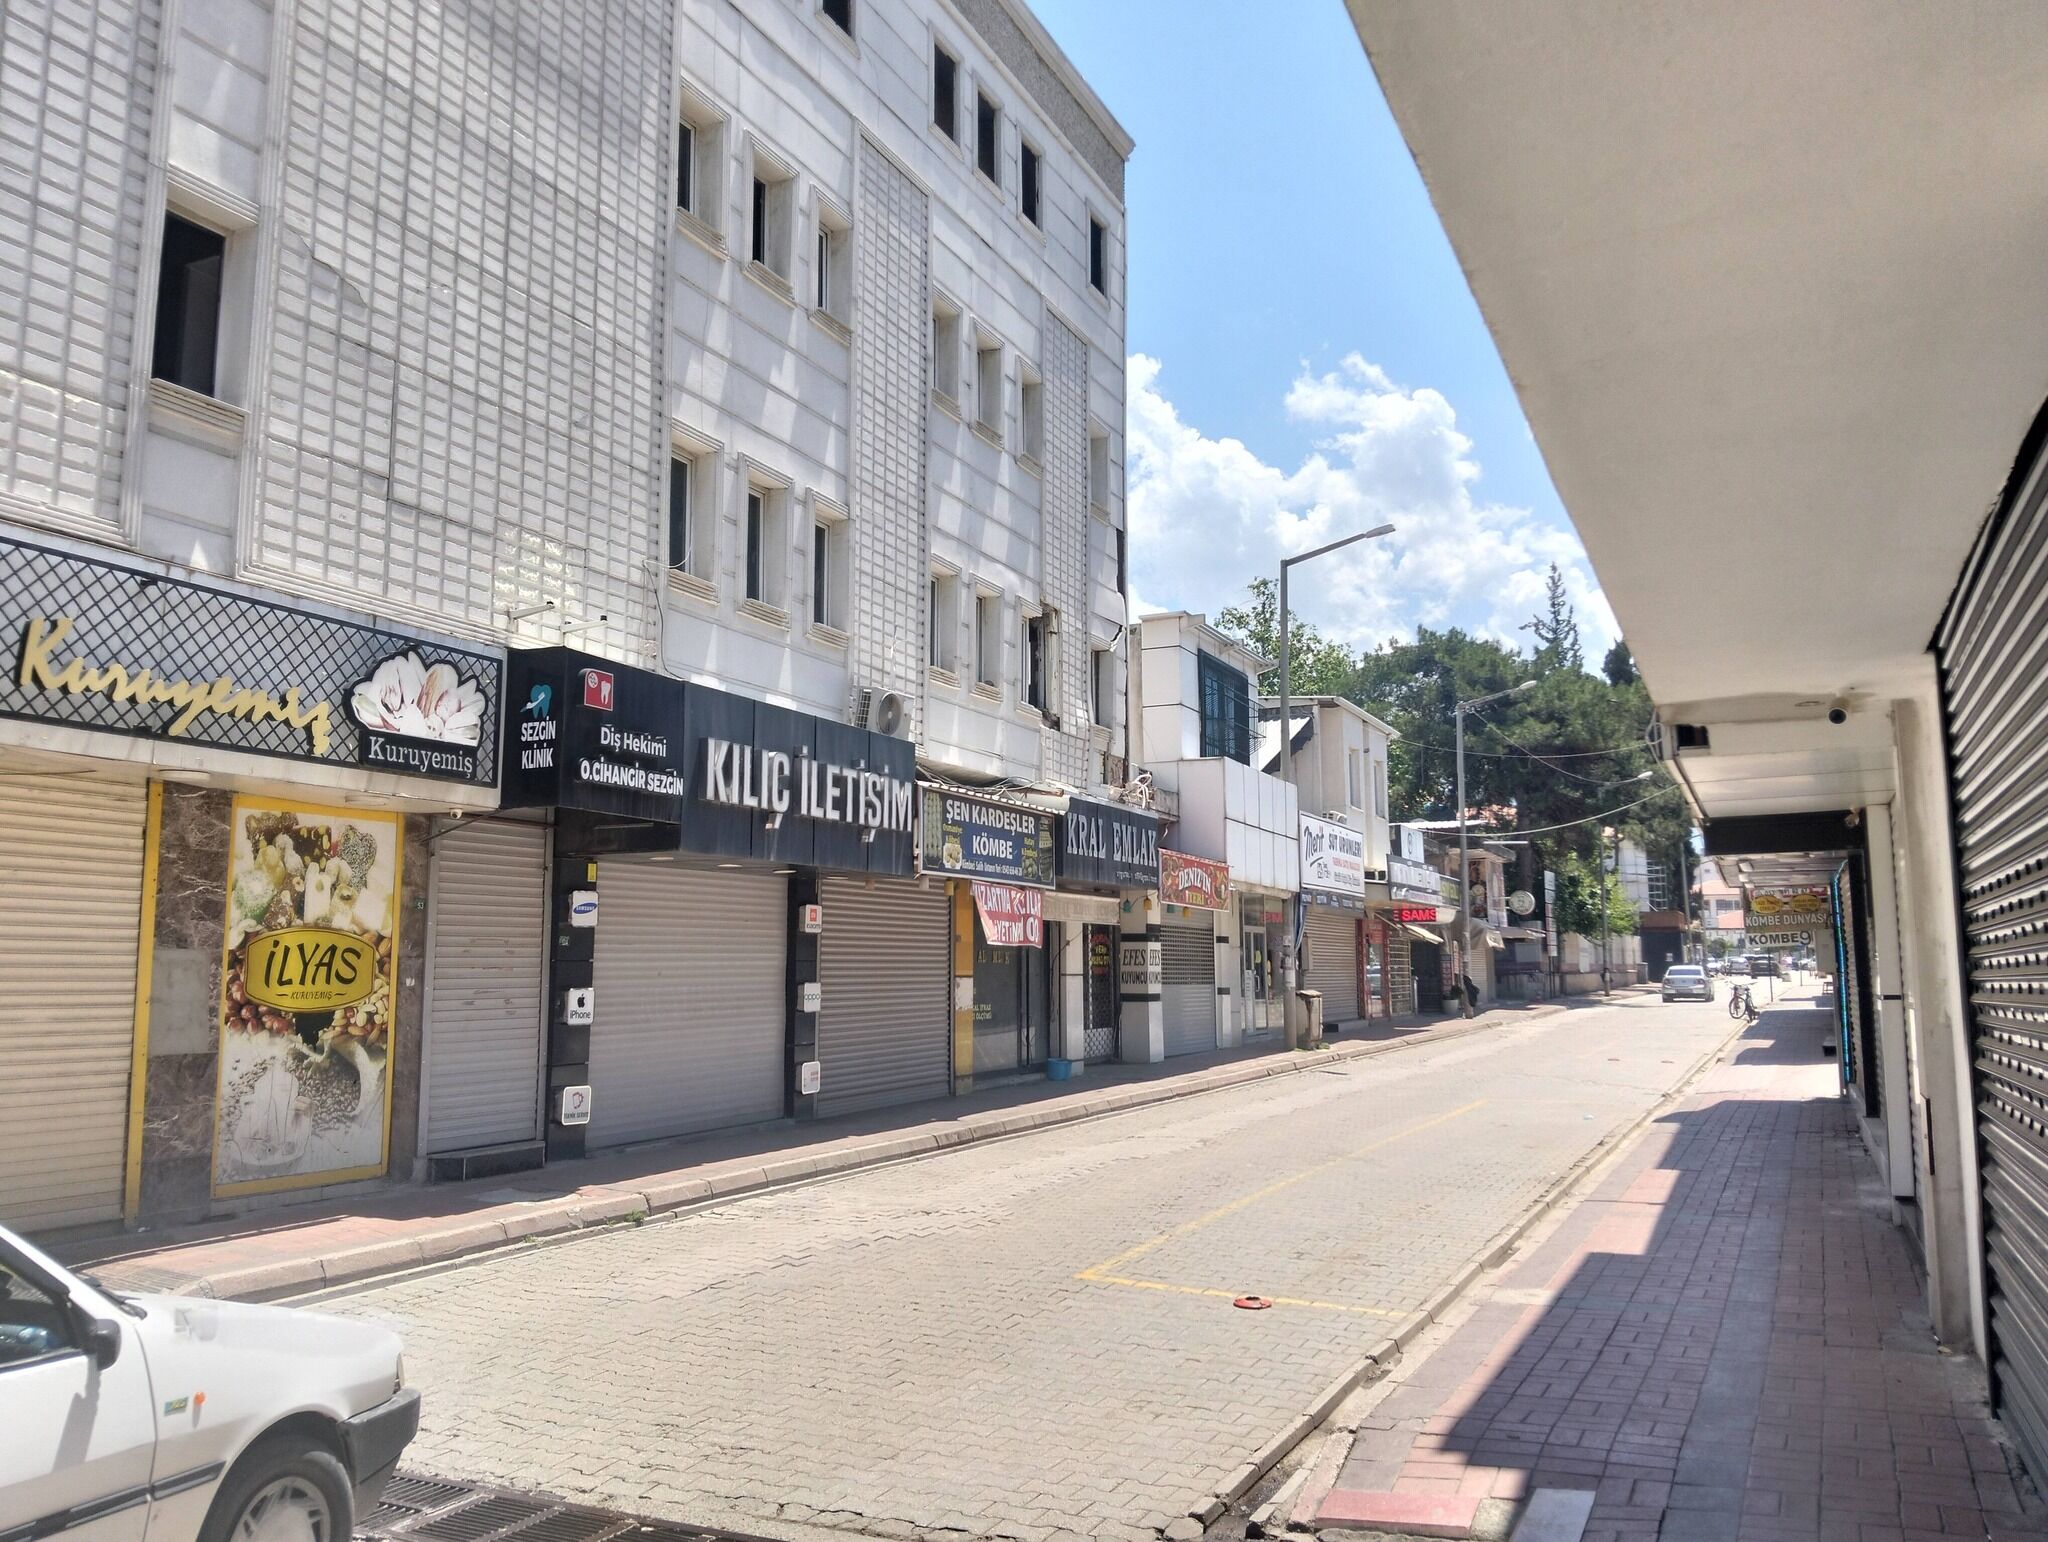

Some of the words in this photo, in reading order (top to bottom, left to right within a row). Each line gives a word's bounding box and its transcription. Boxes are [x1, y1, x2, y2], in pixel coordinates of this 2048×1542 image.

[20, 617, 331, 756] Kuruyemiş
[521, 716, 556, 742] SEZGİN
[600, 725, 621, 752] Diş
[623, 731, 667, 758] Hekimi
[368, 735, 473, 775] Kuruyemiş
[521, 743, 553, 770] KLİNİK
[580, 757, 646, 793] O.CİHANGİR
[647, 764, 684, 796] SEZGİN
[706, 737, 790, 829] KILIÇ
[799, 745, 912, 843] İLETİŞİM
[946, 799, 969, 824] ŞEN
[972, 804, 1035, 836] KARDEŞLER
[972, 832, 1013, 860] KÖMBE
[1067, 812, 1106, 859] KRAL
[1113, 822, 1157, 868] EMLAK
[264, 939, 362, 988] İLYAS
[1122, 949, 1146, 966] EFES
[804, 993, 821, 1001] oppo
[570, 1009, 591, 1021] iPhone
